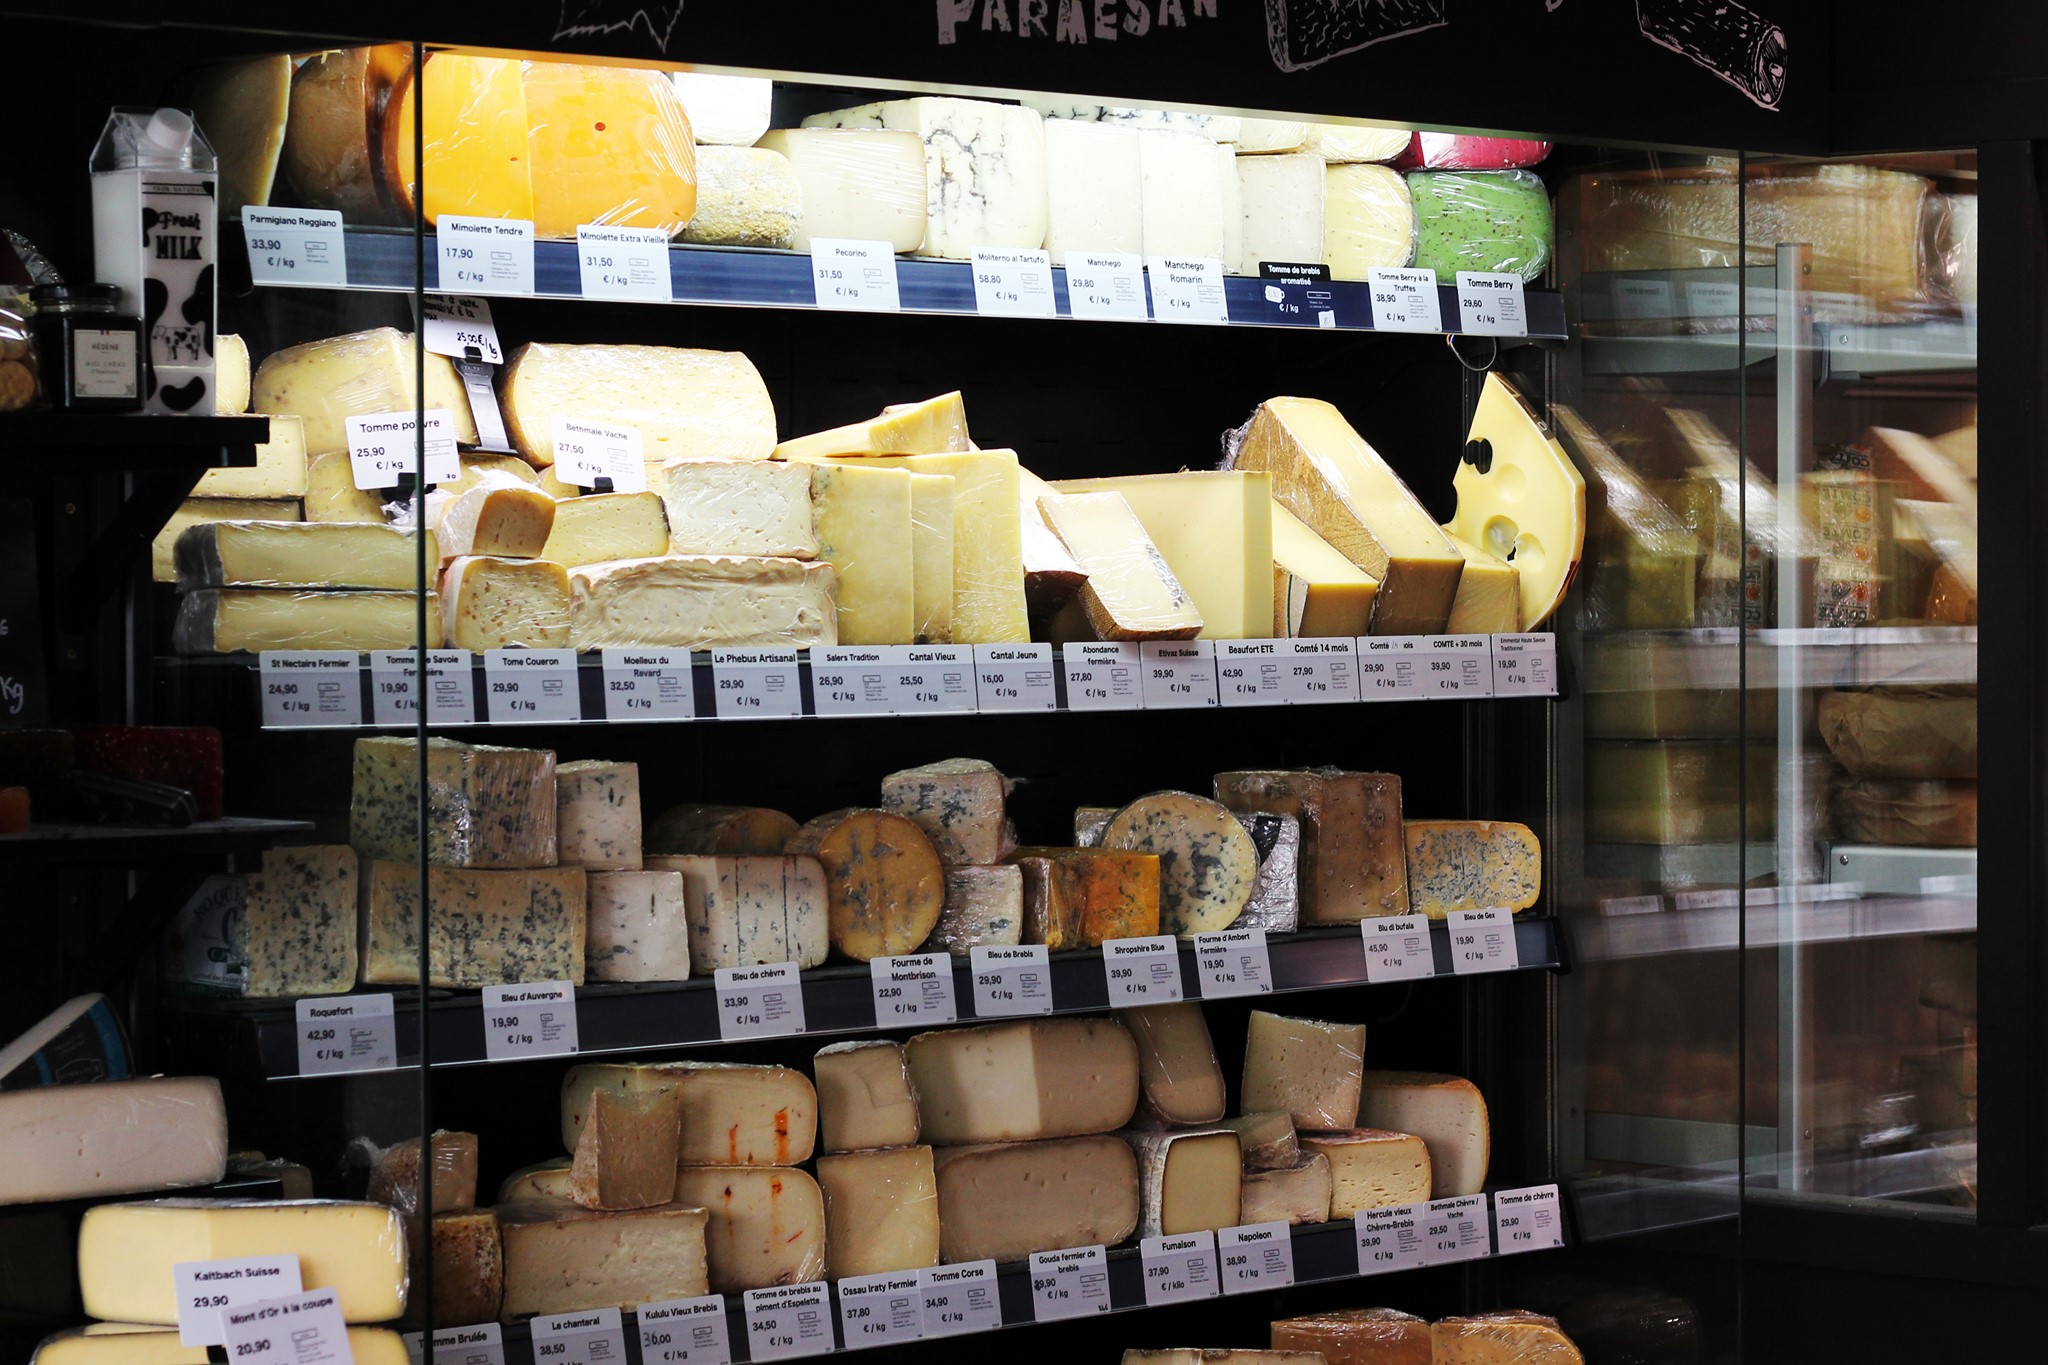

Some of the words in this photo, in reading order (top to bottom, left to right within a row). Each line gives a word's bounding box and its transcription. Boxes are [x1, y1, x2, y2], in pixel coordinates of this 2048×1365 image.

[158, 211, 200, 230] Fresh
[250, 214, 297, 226] Parmigiano
[298, 217, 337, 228] Reggiano
[451, 223, 492, 234] Mimolette
[494, 225, 523, 236] Tendre
[580, 232, 618, 242] Mimolette
[620, 234, 641, 243] Extra
[642, 235, 666, 244] Vieille
[156, 235, 203, 260] MILK
[252, 239, 281, 250] 33,90
[446, 247, 473, 259] 17,90
[835, 248, 867, 258] Pecorino
[978, 253, 1011, 262] Moliterno
[1019, 255, 1045, 264] Tartufo
[587, 256, 613, 267] 31,50
[1087, 258, 1122, 268] Manchego
[1164, 260, 1204, 272] Manchego
[819, 269, 843, 279] 31,50
[1267, 264, 1291, 274] Tomme
[1300, 266, 1321, 275] brebis
[979, 274, 1002, 284] 58,80
[1072, 278, 1094, 288] 29,80
[1170, 274, 1203, 284] Romarin
[1378, 272, 1399, 281] Tomme
[1400, 273, 1417, 283] Berry
[1394, 284, 1416, 292] Truffes
[1467, 278, 1493, 288] Tomme
[1493, 279, 1513, 291] Berry
[1376, 293, 1396, 303] 38,90
[1463, 299, 1483, 308] 29,60
[359, 423, 399, 433] Tomme
[402, 418, 440, 430] povre
[566, 423, 602, 436] Bethmale
[604, 430, 628, 440] Vache
[356, 446, 385, 458] 25,90
[559, 442, 584, 454] 27,50
[1082, 646, 1119, 654] Abondance
[1228, 645, 1260, 654] Beaufort
[1260, 644, 1274, 653] ETE
[1294, 643, 1319, 653] Comté
[1331, 643, 1349, 652] mois
[1369, 642, 1390, 650] Comté
[826, 654, 848, 662] Salers
[849, 653, 880, 661] Tradition
[909, 652, 934, 661] Cantal
[934, 652, 956, 661] Vieux
[990, 651, 1015, 660] Cantal
[1016, 651, 1038, 660] Jeune
[1178, 648, 1199, 657] Suisse
[282, 659, 317, 668] Nectaire
[318, 659, 350, 668] Fermier
[386, 655, 415, 664] Tomme
[433, 655, 459, 664] Savoie
[502, 657, 524, 666] Tome
[525, 657, 559, 666] Coueron
[624, 656, 657, 665] Moelleux
[726, 654, 757, 663] Phebus
[759, 654, 796, 663] Artisanal
[1087, 657, 1116, 666] fermière
[1498, 659, 1517, 669] 19,90
[1293, 667, 1313, 676] 27,90
[1364, 663, 1384, 673] 29,90
[1431, 661, 1451, 671] 39,90
[633, 669, 661, 677] Revard
[1070, 672, 1092, 682] 27,80
[1153, 669, 1174, 679] 39,90
[1222, 668, 1243, 678] 42,90
[720, 679, 744, 689] 29,90
[819, 676, 844, 687] 26,90
[900, 676, 923, 686] 25,50
[982, 674, 1004, 684] 16,00
[268, 684, 298, 695] 24,90
[381, 682, 408, 694] 19,90
[493, 682, 519, 693] 29,90
[610, 681, 635, 691] 32,50
[1464, 913, 1476, 921] Bleu
[1395, 922, 1414, 931] bufala
[1198, 936, 1221, 944] Fourme
[1222, 933, 1250, 942] d'Ambert
[1455, 935, 1474, 945] 19,90
[1114, 945, 1150, 955] Shropshire
[1150, 943, 1165, 952] Blue
[1200, 946, 1228, 955] Fermière
[1368, 943, 1388, 953] 45,90
[987, 951, 1002, 959] Bleu
[1012, 950, 1034, 958] Brebis
[891, 959, 922, 968] Fourme
[1203, 959, 1225, 970] 19,90
[732, 973, 748, 981] Bleu
[760, 969, 786, 978] chèvre
[891, 970, 937, 982] Montbrison
[1111, 968, 1132, 979] 39,90
[978, 975, 1002, 986] 29,90
[501, 994, 518, 1003] Bleu
[519, 992, 563, 1001] d'Auvergne
[878, 987, 902, 998] 22,90
[724, 996, 749, 1008] 33,90
[310, 1007, 353, 1018] Roquefort
[492, 1016, 519, 1028] 19,90
[307, 1029, 335, 1041] 42,90
[1500, 1196, 1523, 1205] Tomme
[1533, 1191, 1554, 1201] chèvre
[1430, 1201, 1455, 1212] Bethmale
[1455, 1199, 1475, 1208] Chèvre
[1366, 1209, 1393, 1220] Hercule
[1393, 1208, 1412, 1216] vieux
[1366, 1219, 1414, 1233] Chèvre-Brebis
[1501, 1217, 1519, 1227] 29,90
[1429, 1225, 1448, 1236] 29,50
[1238, 1231, 1272, 1243] Napoleon
[1361, 1237, 1381, 1247] 39,90
[1162, 1240, 1196, 1251] Fumaison
[1038, 1254, 1060, 1264] Gouda
[1061, 1251, 1086, 1261] fermier
[1226, 1255, 1247, 1266] 38,90
[194, 1270, 242, 1281] Kaltbach
[245, 1268, 280, 1277] Suisse
[1057, 1264, 1080, 1274] brebis
[1148, 1266, 1169, 1277] 37,90
[931, 1272, 960, 1282] Tomme
[961, 1269, 984, 1278] Corse
[751, 1291, 777, 1300] Tomme
[788, 1286, 811, 1296] brebis
[842, 1287, 867, 1296] Ossau
[868, 1283, 887, 1293] Iraty
[888, 1279, 918, 1290] Fermier
[194, 1295, 229, 1308] 29,90
[755, 1302, 781, 1314] piment
[781, 1297, 820, 1309] d'Espelette
[925, 1296, 948, 1308] 34,90
[230, 1312, 256, 1324] Mont
[302, 1297, 333, 1310] coupe
[670, 1307, 692, 1317] Vieux
[693, 1303, 718, 1314] Brebis
[847, 1307, 870, 1319] 37,80
[563, 1316, 600, 1329] chanteral
[752, 1320, 777, 1332] 34,50
[457, 1331, 487, 1344] Brulée
[236, 1339, 271, 1356] 20,90
[539, 1343, 566, 1356] 38,50
